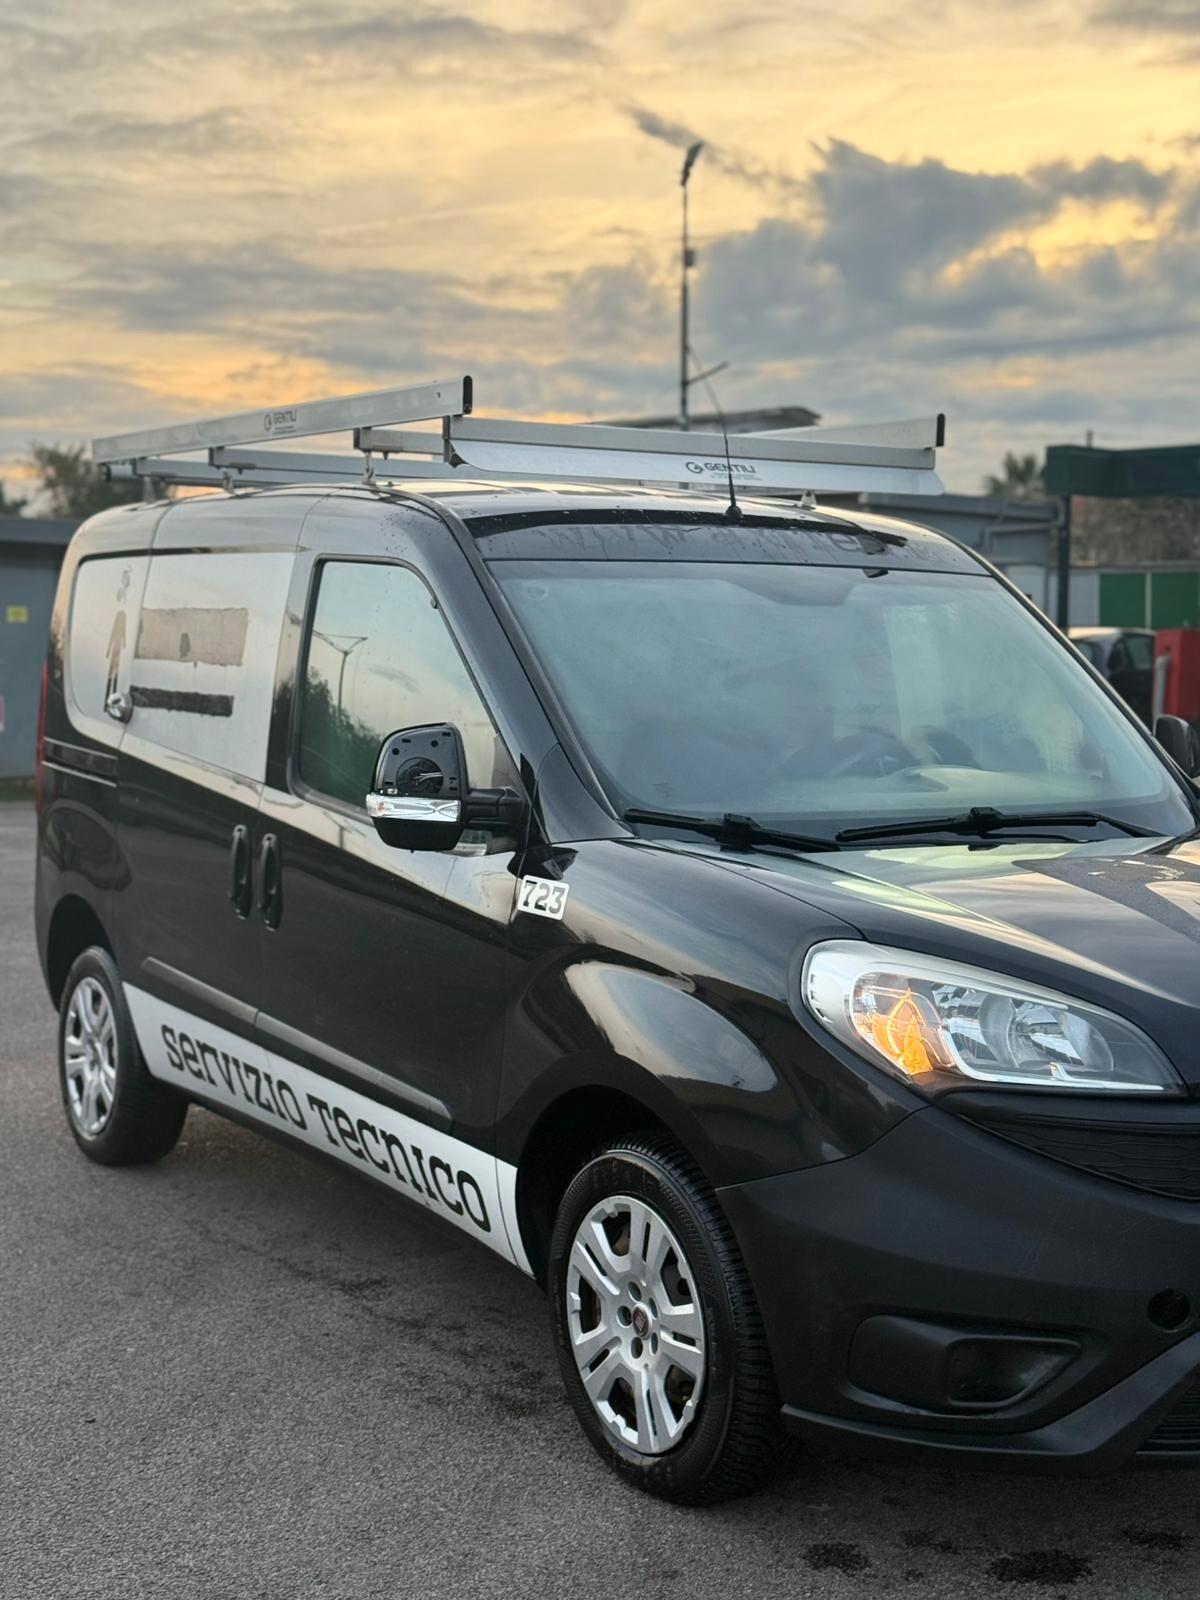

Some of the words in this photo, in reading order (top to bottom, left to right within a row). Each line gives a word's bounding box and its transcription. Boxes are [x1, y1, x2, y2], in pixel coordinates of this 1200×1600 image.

[704, 462, 757, 474] GENTILI
[523, 880, 566, 914] 723
[161, 1024, 307, 1131] servizio
